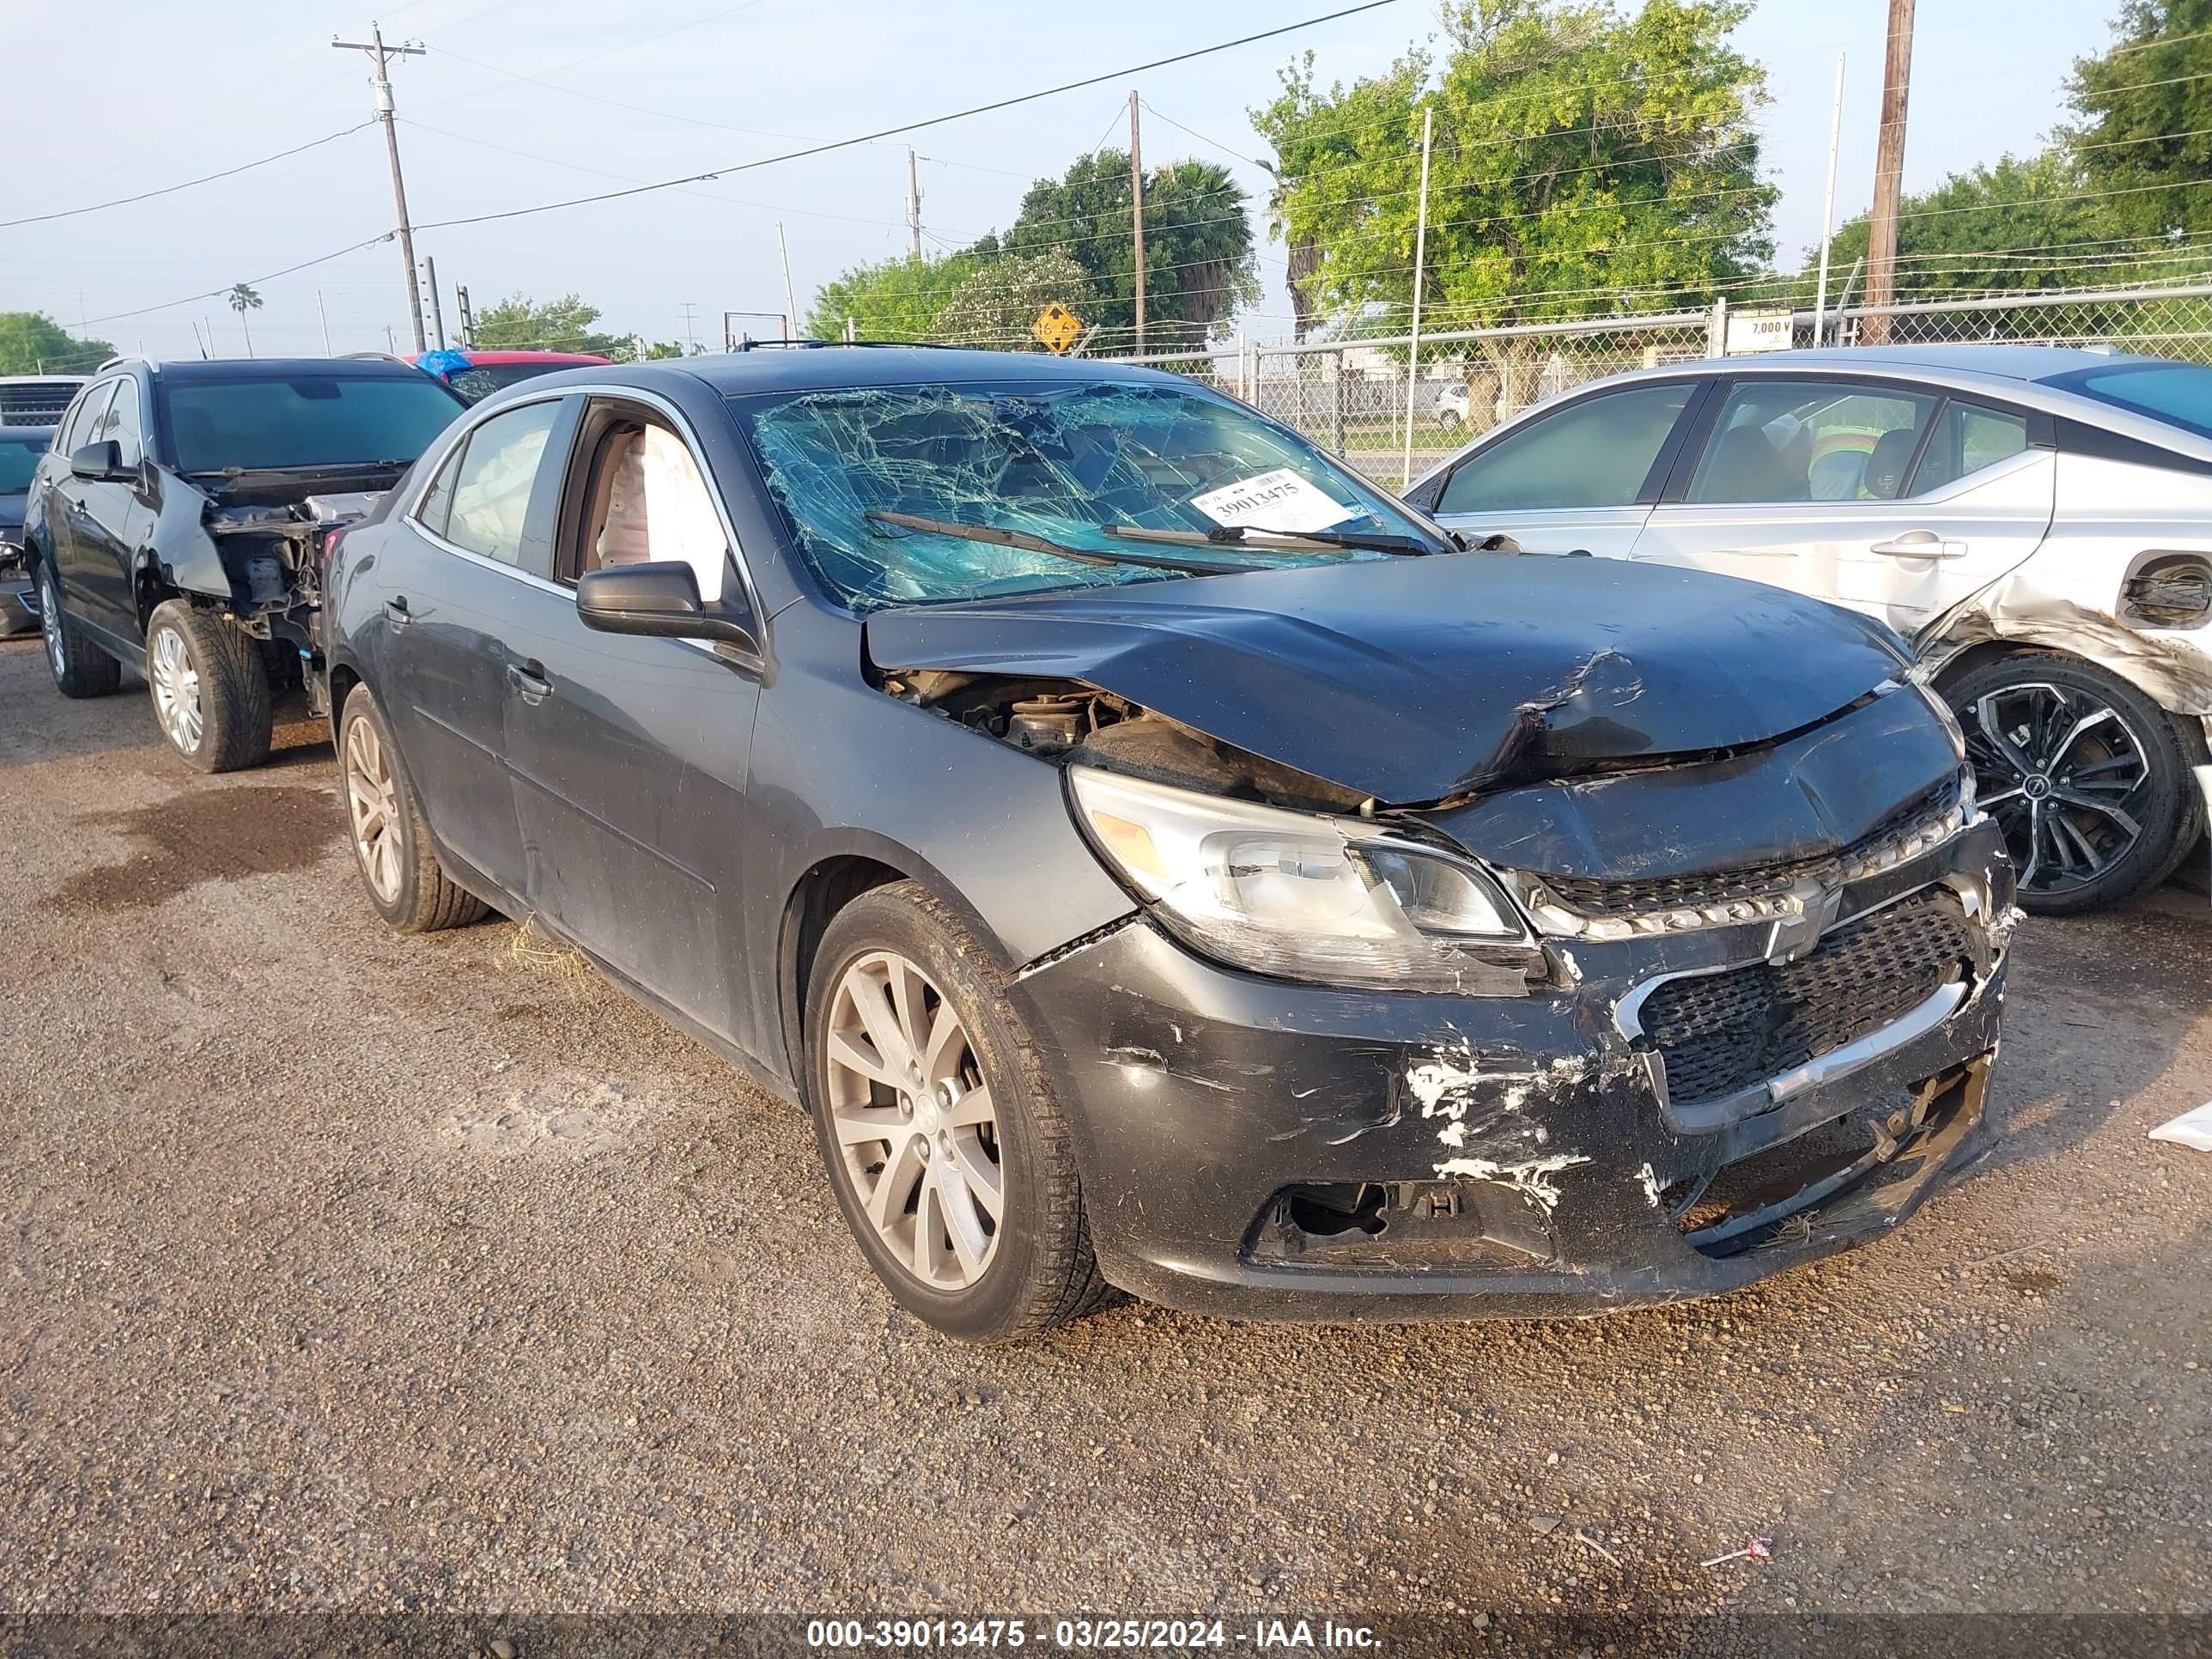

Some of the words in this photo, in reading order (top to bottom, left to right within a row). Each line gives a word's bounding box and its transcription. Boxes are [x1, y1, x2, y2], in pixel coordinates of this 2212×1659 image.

[1039, 322, 1052, 335] 16
[1753, 322, 1781, 334] 7,000
[1784, 321, 1791, 331] V
[1216, 483, 1299, 518] 39013475
